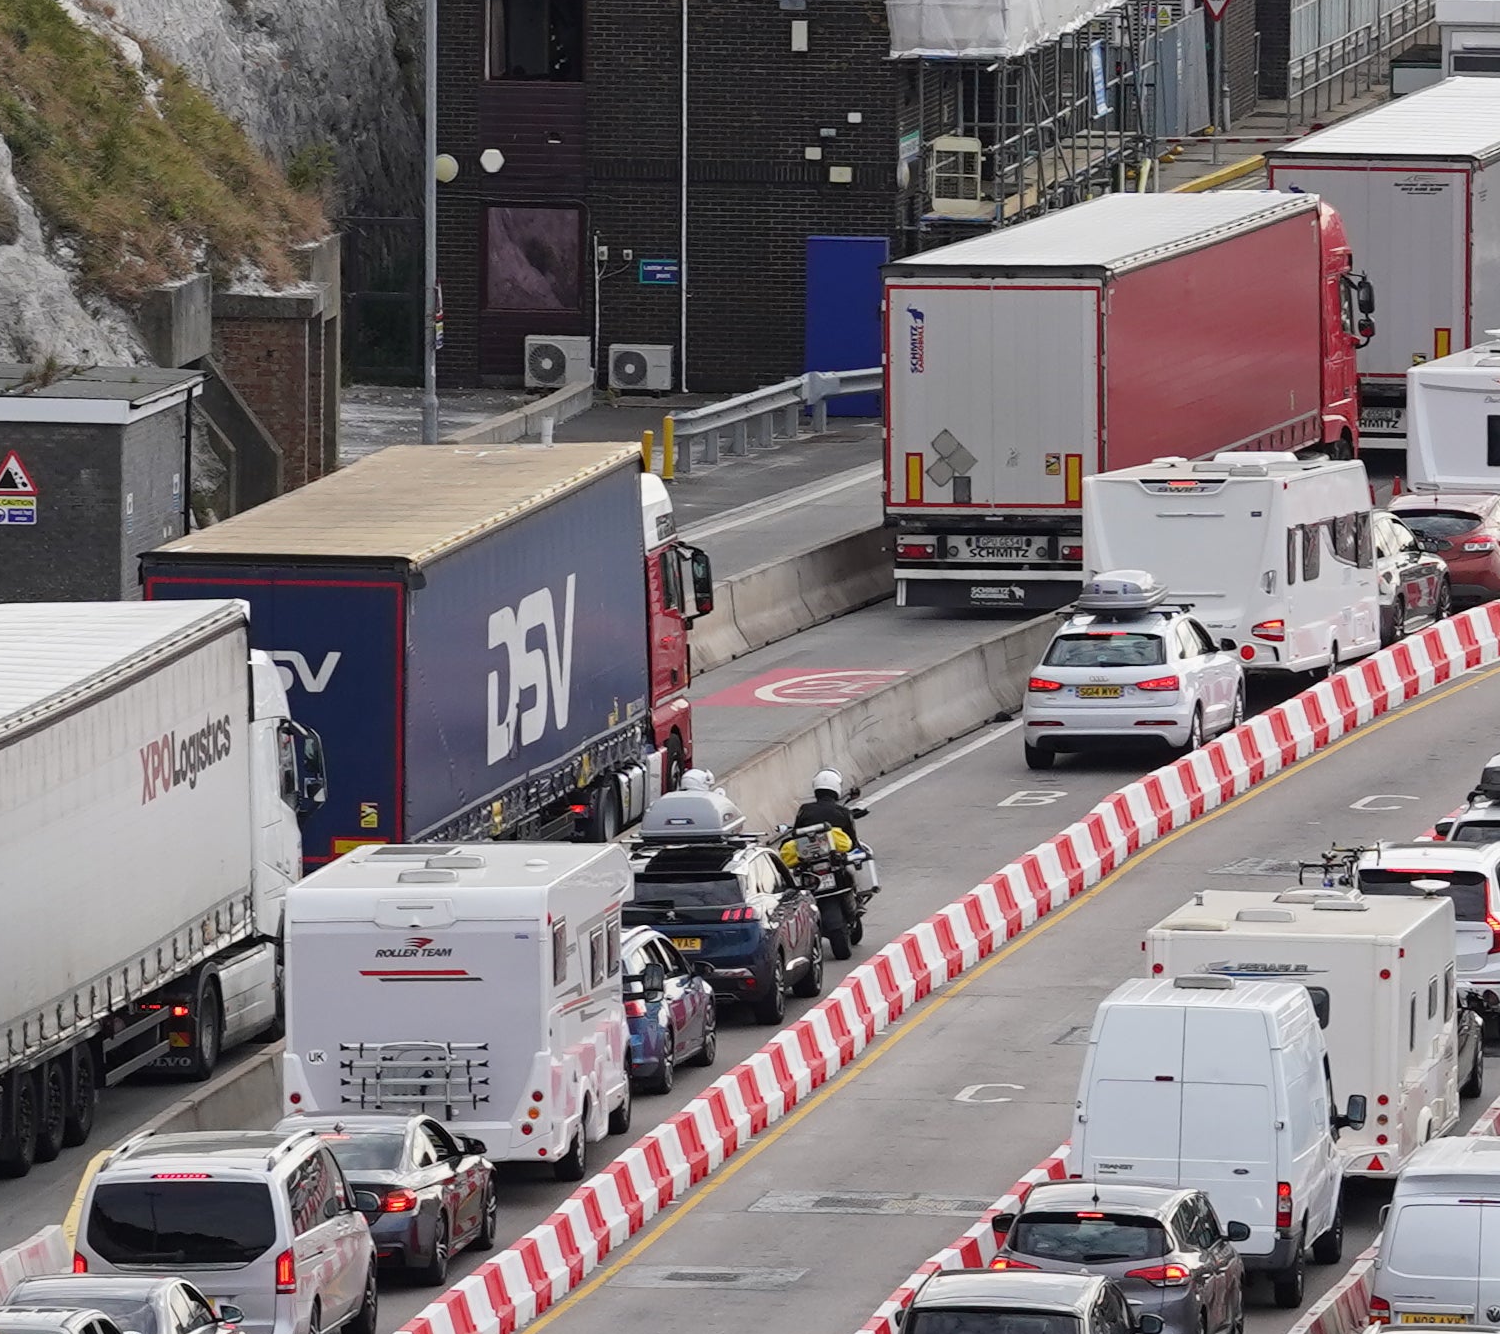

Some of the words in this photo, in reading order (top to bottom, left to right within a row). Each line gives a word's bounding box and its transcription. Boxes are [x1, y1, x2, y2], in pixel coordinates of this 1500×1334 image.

[909, 324, 918, 374] SCHMITZ
[1157, 486, 1207, 494] SWIFT
[1, 499, 34, 507] CAUTION
[968, 547, 1030, 559] SCHMITZ
[486, 571, 578, 767] DSV
[140, 713, 231, 806] XPOLogistics
[996, 790, 1069, 807] B
[1348, 794, 1420, 810] C
[375, 948, 419, 958] ROLLER
[420, 948, 452, 958] TEAM
[308, 1051, 325, 1063] UK
[954, 1082, 1026, 1103] C
